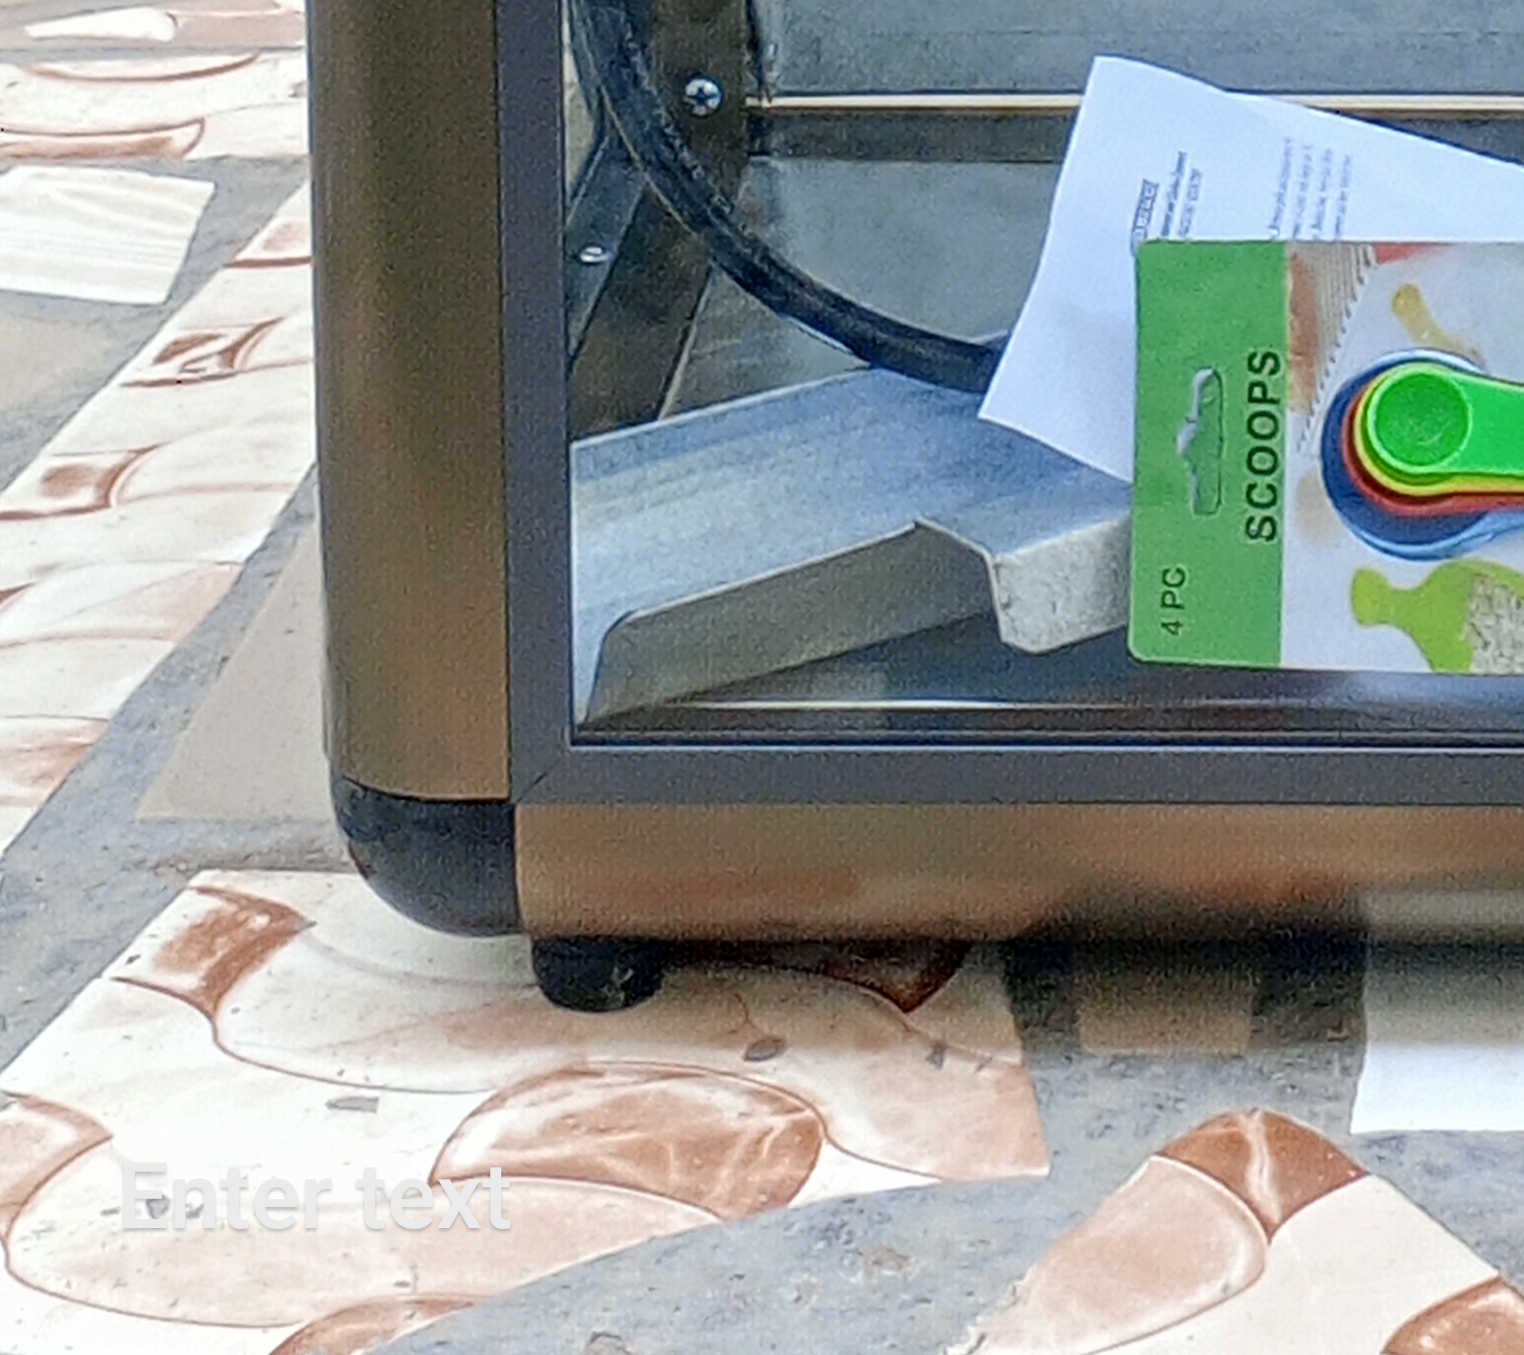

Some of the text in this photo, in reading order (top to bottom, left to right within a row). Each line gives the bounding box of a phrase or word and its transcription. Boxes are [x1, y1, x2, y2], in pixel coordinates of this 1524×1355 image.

[1244, 350, 1281, 543] SCOOPS
[1160, 566, 1186, 637] 4 PC
